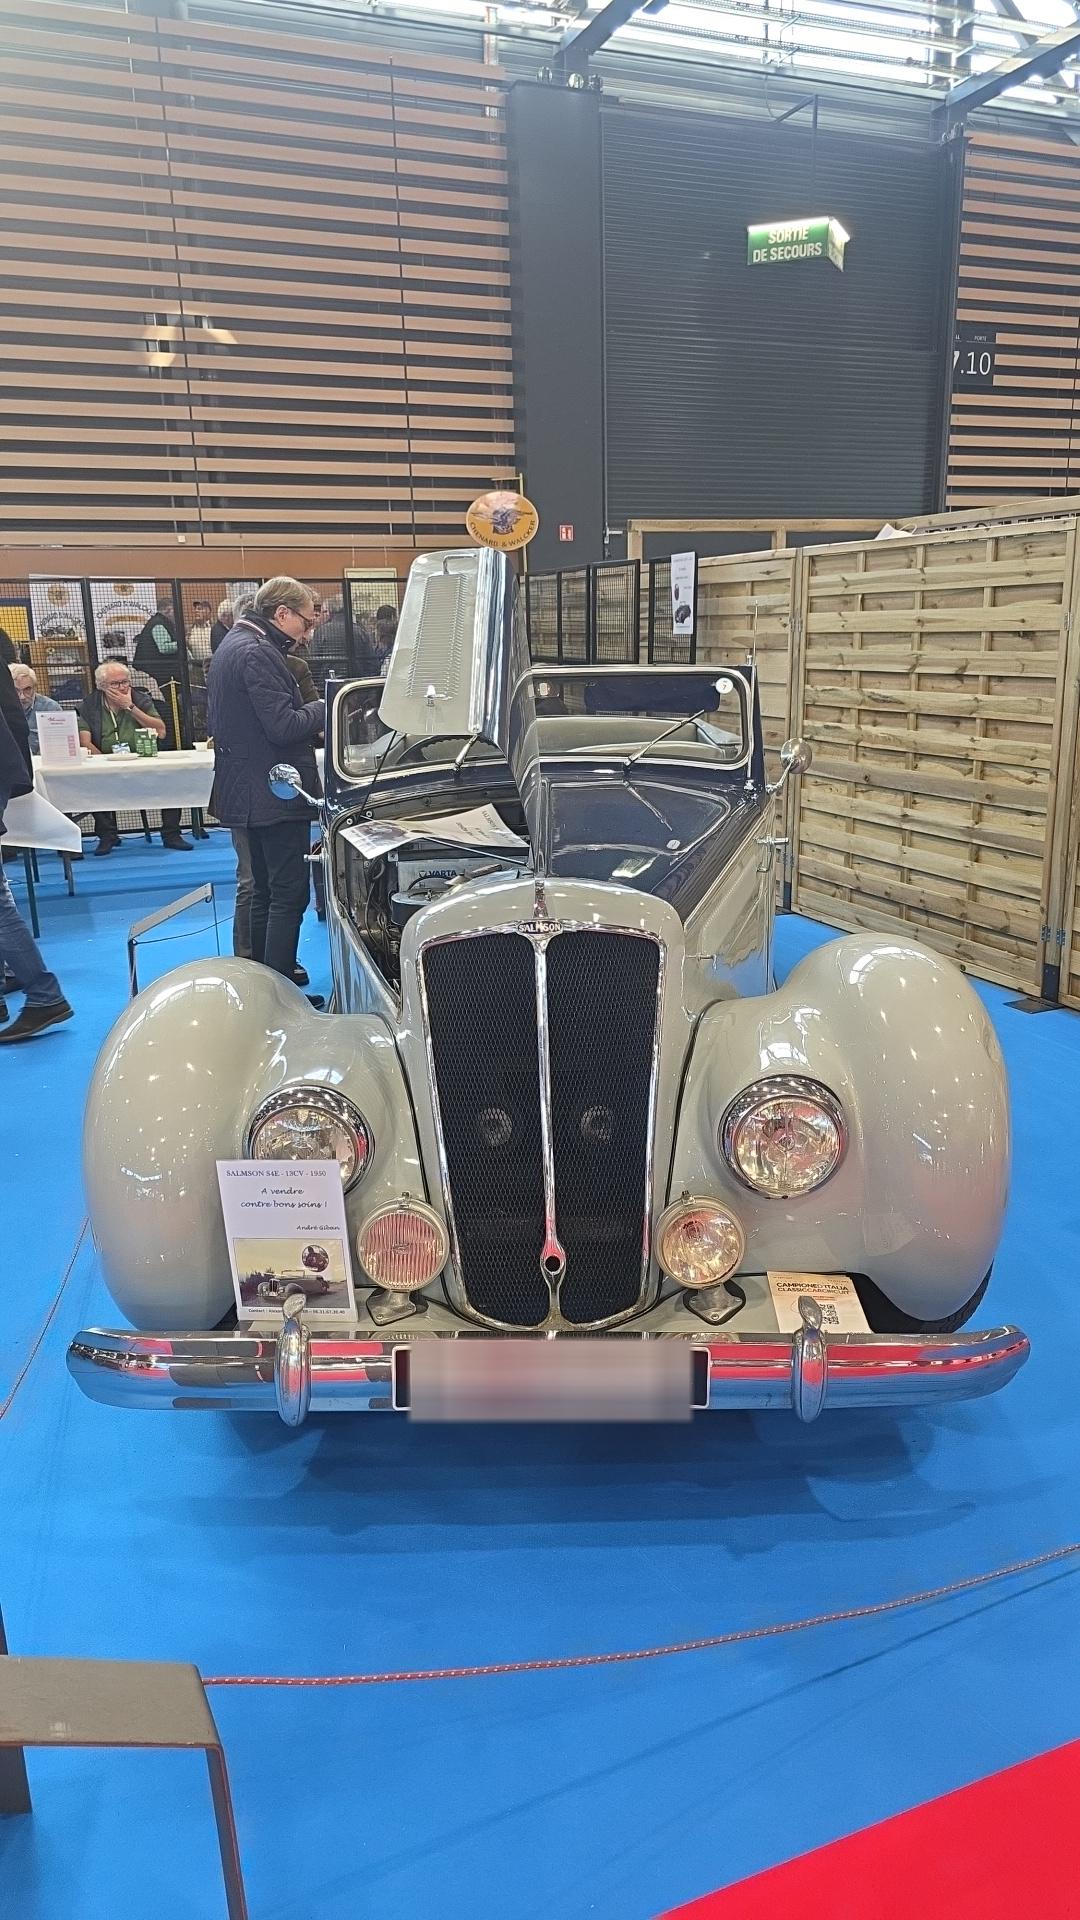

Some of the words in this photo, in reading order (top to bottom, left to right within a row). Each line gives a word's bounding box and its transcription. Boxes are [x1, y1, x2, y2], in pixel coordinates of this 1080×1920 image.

[768, 226, 809, 244] SORTIE
[752, 248, 768, 263] DE
[769, 242, 823, 260] SECOURS
[469, 521, 499, 547] CHENARD
[508, 520, 536, 547] WALCKER
[429, 868, 457, 877] VARTA
[518, 921, 561, 934] SALMSON
[226, 1169, 264, 1178] SALMSON
[266, 1169, 280, 1177] S4E
[261, 1187, 268, 1195] A
[270, 1187, 305, 1195] vendre
[273, 1199, 295, 1208] bons
[296, 1200, 323, 1209] soins
